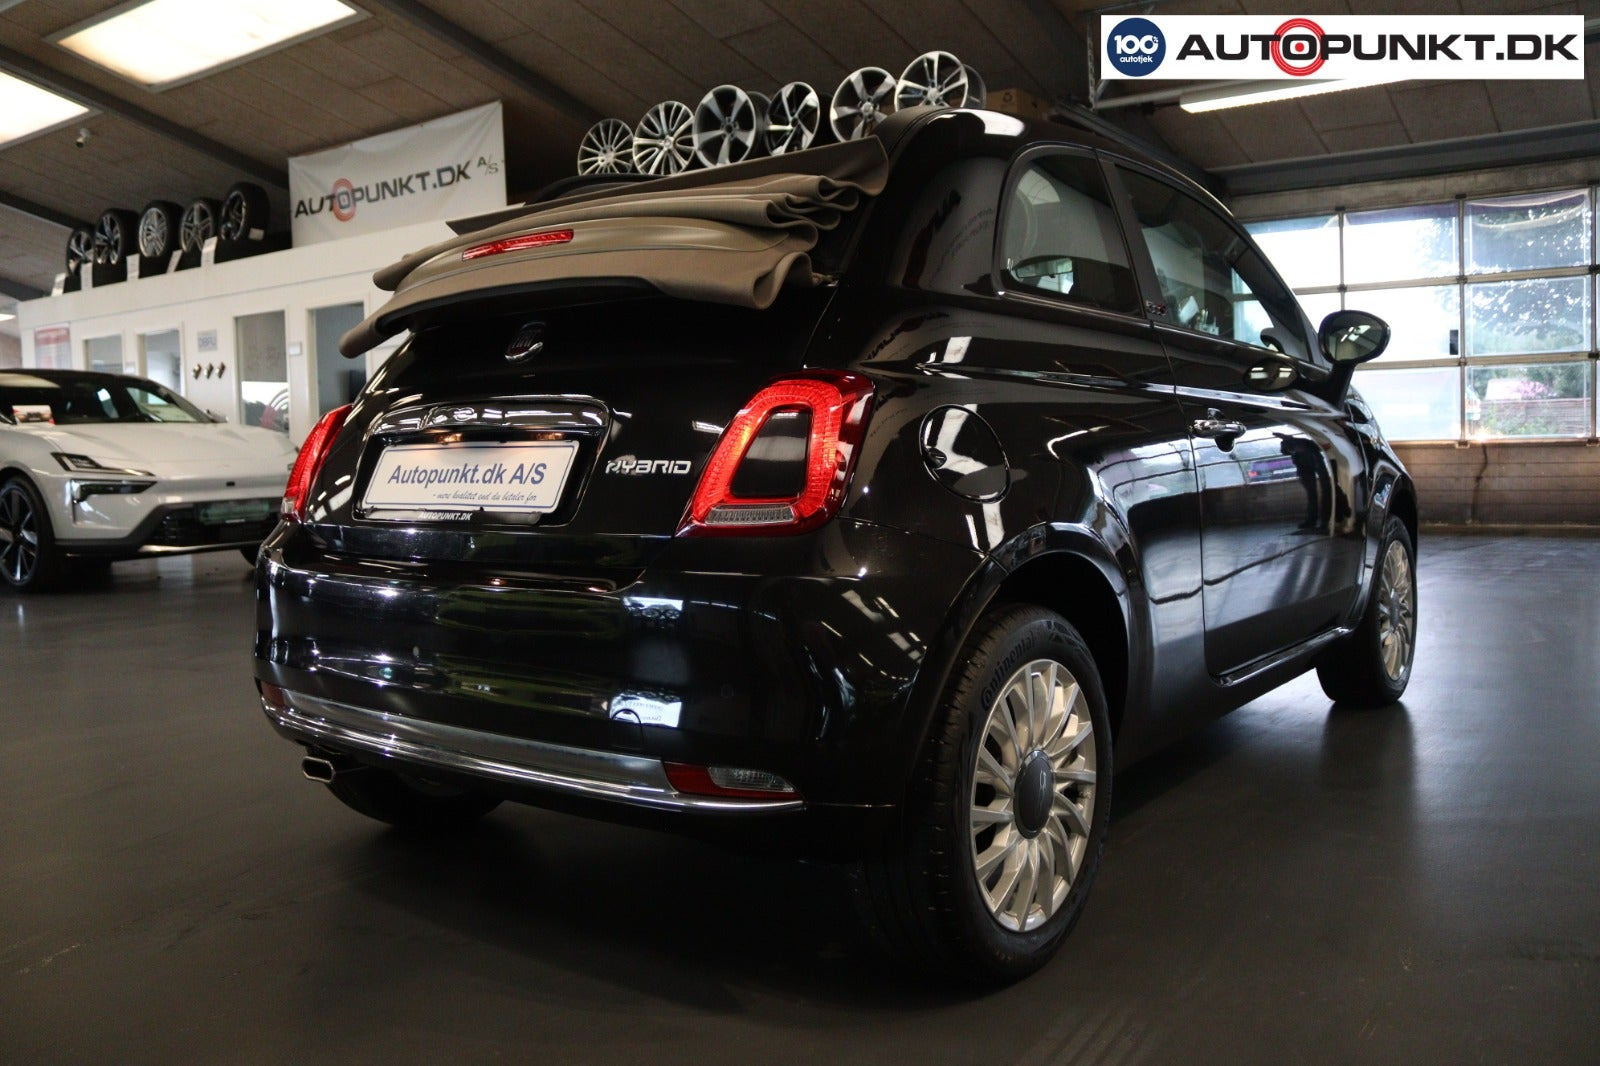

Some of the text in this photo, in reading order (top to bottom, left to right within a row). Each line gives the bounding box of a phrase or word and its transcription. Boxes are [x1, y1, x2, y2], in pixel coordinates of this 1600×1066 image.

[294, 154, 499, 218] AUTOPUNKT.DK A/S
[388, 463, 547, 488] Autopunkt.dk A/S
[605, 459, 692, 474] HYBRID
[981, 629, 1037, 712] Continental
